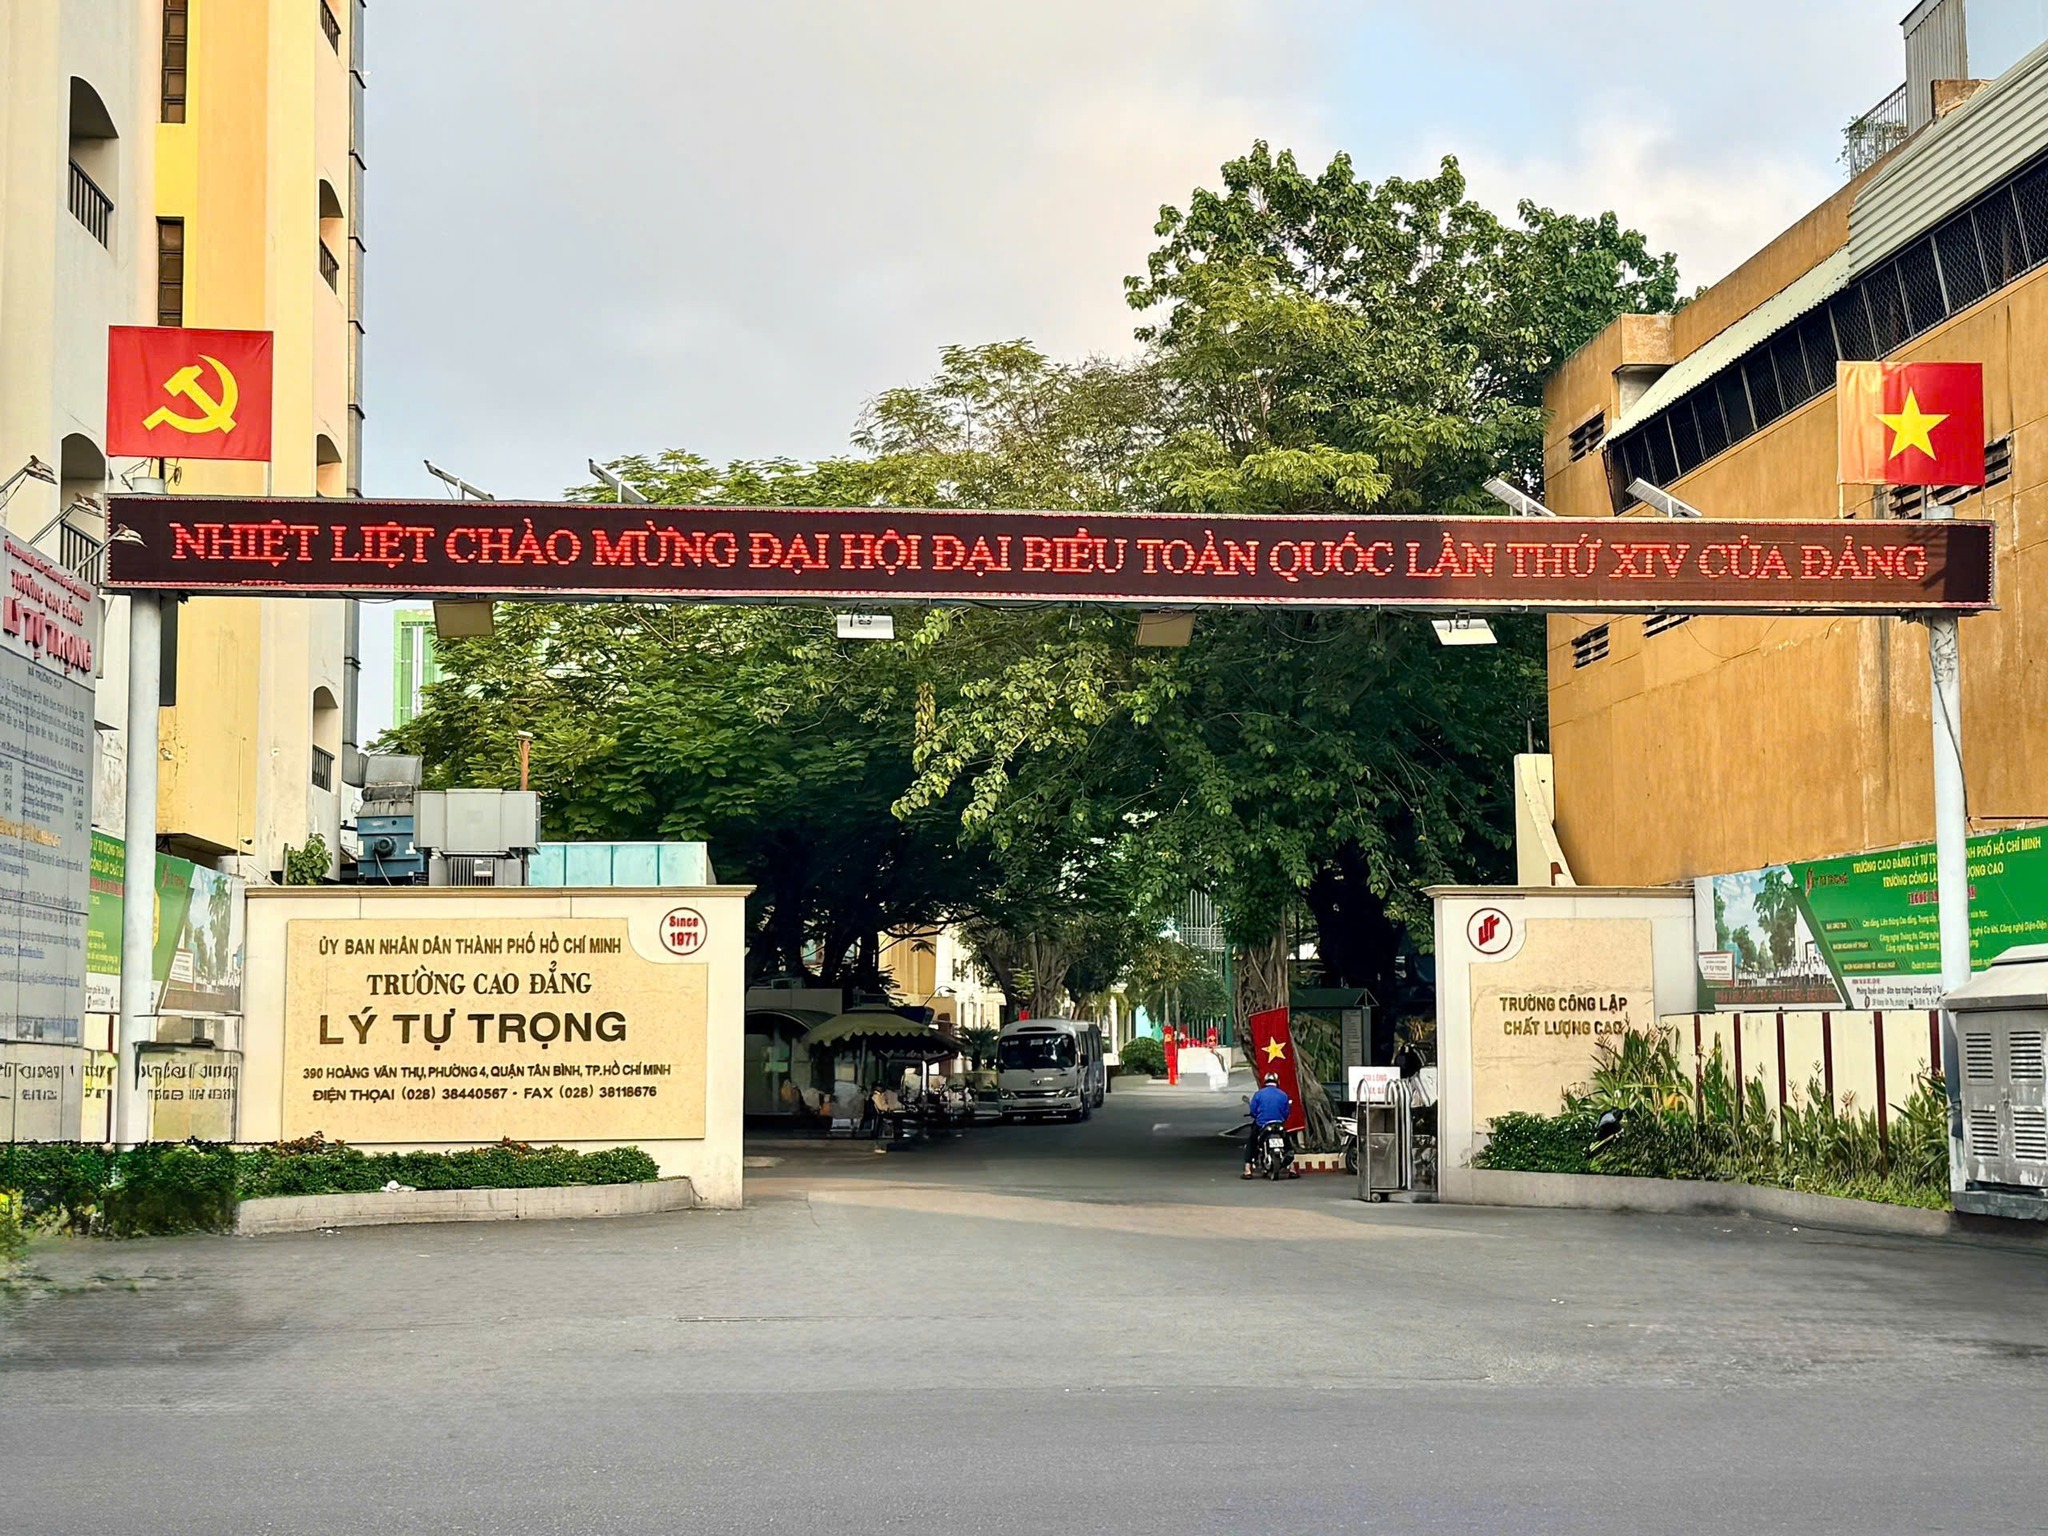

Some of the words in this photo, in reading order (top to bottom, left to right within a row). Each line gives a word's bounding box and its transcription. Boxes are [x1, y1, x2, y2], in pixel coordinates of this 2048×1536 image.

[170, 519, 319, 567] NHIỆT
[330, 521, 434, 568] LIỆT
[445, 518, 582, 565] CHÀO
[591, 520, 739, 568] MỪNG
[749, 532, 829, 574] ĐẠI
[840, 528, 922, 575] HỘI
[933, 535, 1012, 577] ĐẠI
[1022, 527, 1128, 574] BIỂU
[1136, 529, 1260, 576] TOÀN
[1268, 531, 1394, 582] QUỐC
[1405, 531, 1497, 578] LẦN
[1506, 533, 1602, 578] THỨ
[1609, 542, 1691, 579] XIV
[1698, 534, 1793, 580] CỦA
[1800, 534, 1929, 581] ĐẢNG
[2021, 836, 2042, 851] MINH
[1877, 858, 1891, 870] CAO
[1987, 861, 2004, 875] CAO
[669, 915, 699, 927] Since
[319, 936, 339, 955] ỦY
[345, 938, 375, 955] BAN
[379, 935, 418, 955] NHÂN
[422, 935, 451, 954] DÂN
[455, 935, 503, 955] THÀNH
[507, 931, 536, 954] PHỐ
[540, 931, 560, 954] HỒ
[563, 935, 587, 954] CHÍ
[589, 938, 621, 954] MINH
[670, 932, 698, 946] 1971
[366, 964, 466, 995] TRƯỜNG
[473, 972, 520, 995] CAO
[529, 960, 592, 995] ĐẲNG
[1499, 993, 1555, 1011] TRƯỜNG
[1558, 993, 1596, 1012] CÔNG
[1600, 993, 1628, 1014] LẬP
[319, 1006, 378, 1045] LÝ
[392, 1008, 456, 1051] TỰ
[467, 1011, 627, 1050] TRỌNG
[1503, 1016, 1540, 1035] CHẤT
[1544, 1019, 1591, 1038] LƯỢNG
[1594, 1020, 1623, 1035] CAO
[303, 1068, 323, 1079] 390
[326, 1065, 369, 1079] HOÀNG
[373, 1065, 397, 1078] VĂN
[491, 1063, 524, 1079] QUẬN
[527, 1063, 550, 1077] TÂN
[553, 1062, 583, 1078] BÌNH,
[622, 1062, 642, 1076] CHÍ
[643, 1064, 671, 1076] MINH
[313, 1087, 346, 1103] ĐIỆN
[401, 1086, 436, 1100] (028)
[442, 1088, 508, 1099] 38440567
[524, 1087, 553, 1099] FAX
[559, 1084, 594, 1099] (028)
